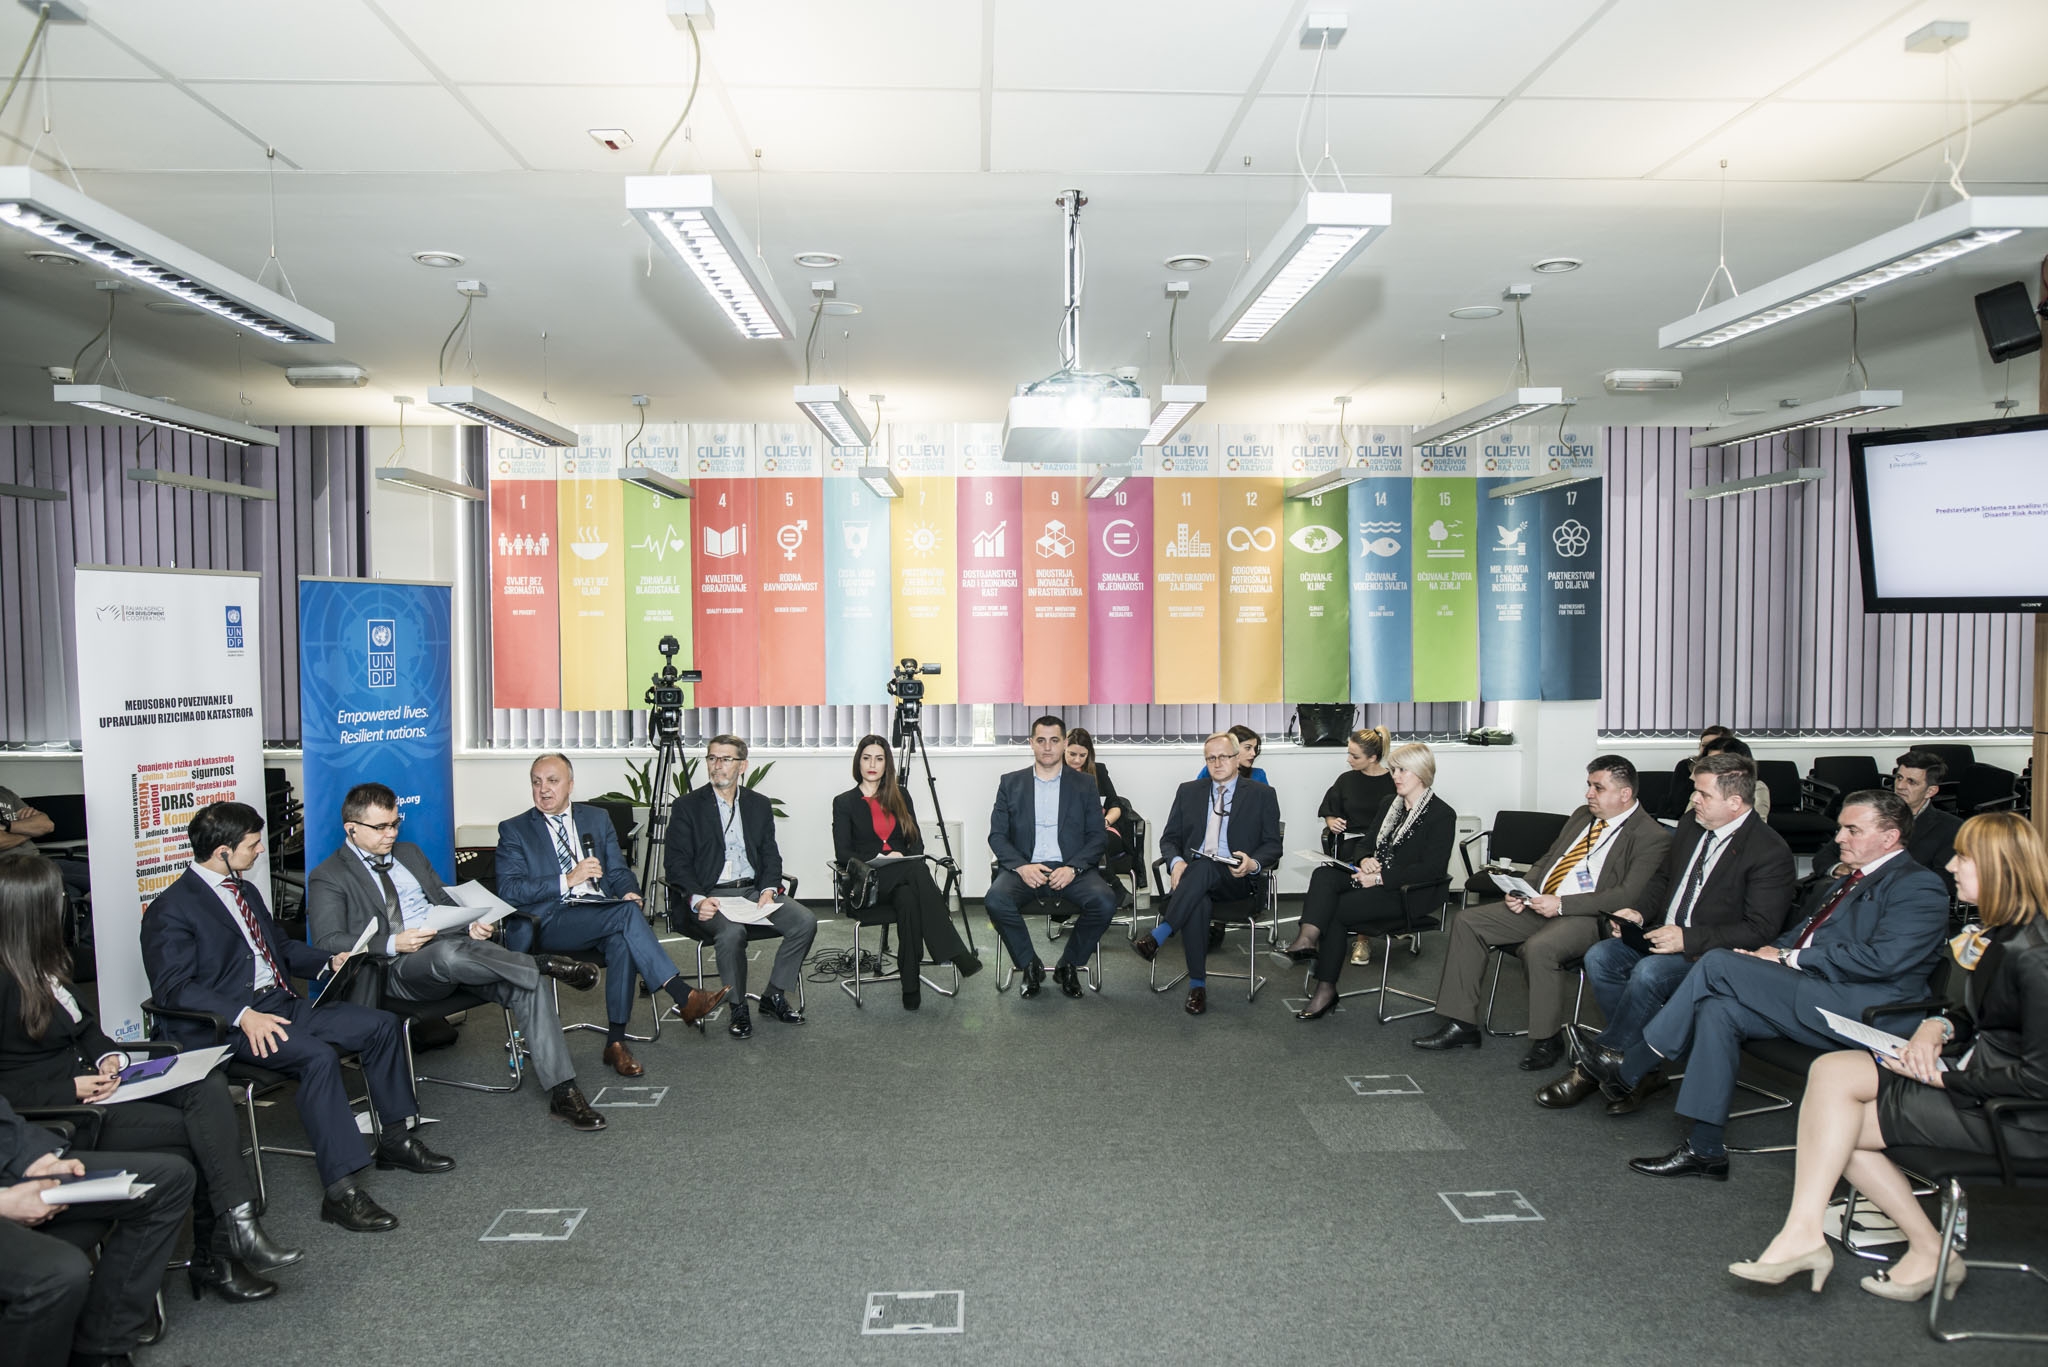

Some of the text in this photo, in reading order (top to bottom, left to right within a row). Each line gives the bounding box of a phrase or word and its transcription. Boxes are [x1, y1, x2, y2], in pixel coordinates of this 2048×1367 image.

[498, 447, 546, 460] CILJEVI
[564, 447, 612, 459] CILJEVI
[631, 447, 679, 459] CILJEVI
[697, 446, 745, 458] CILJEVI
[764, 445, 812, 458] CILJEVI
[897, 445, 945, 457] CILJEVI
[964, 445, 1003, 457] CILJE
[1161, 445, 1209, 457] CILJEVI
[1227, 445, 1274, 457] CILJEVI
[1292, 446, 1339, 458] CILJEVI
[1356, 445, 1402, 458] CILJEVI
[1421, 445, 1467, 458] CILJEVI
[1484, 445, 1530, 457] CILJEVI
[1548, 445, 1593, 457] CILJEVI
[1043, 463, 1077, 471] RAZVOJA
[1174, 464, 1209, 472] RAZVOJA
[1240, 464, 1273, 472] RAZVOJA
[1369, 464, 1402, 472] RAZVOJA
[1433, 464, 1466, 472] RAZVOJA
[1497, 464, 1530, 472] RAZVOJA
[520, 494, 526, 509] 1
[585, 494, 593, 509] 2
[652, 494, 661, 509] 3
[718, 493, 727, 508] 4
[785, 492, 794, 507] 5
[851, 492, 860, 506] 6
[920, 491, 926, 506] 7
[985, 491, 993, 506] 8
[1051, 491, 1059, 506] 9
[1114, 492, 1127, 506] 10
[1181, 492, 1192, 506] 11
[1246, 492, 1258, 506] 12
[1311, 495, 1323, 507] 13
[1375, 492, 1387, 506] 14
[1439, 492, 1451, 506] 15
[1566, 491, 1577, 506] 17
[1935, 506, 1980, 515] Predstavljanje
[1981, 504, 2008, 512] Sistema
[962, 569, 1017, 579] DOSTOJANSTVEN
[1232, 566, 1271, 575] ODGOVORNA
[1504, 564, 1529, 574] PRAVDA
[506, 576, 542, 586] SVIJET BEZ
[705, 574, 744, 584] KVALITETNO
[779, 573, 802, 582] RODNA
[1102, 572, 1140, 582] SMANJENJE
[1231, 574, 1269, 584] POTROŠNJA
[1300, 571, 1333, 582] OČUVANJE
[1365, 571, 1398, 581] OČUVANJE
[1417, 570, 1473, 582] OČUVANJE ŽIVOTA
[1499, 573, 1523, 583] SNAŽNE
[1547, 571, 1595, 581] PARTNERSTVOM
[701, 583, 748, 593] OBRAZOVANJE
[763, 582, 819, 592] RAVNOPRAVNOST
[962, 579, 976, 588] RAD
[1037, 578, 1070, 588] INOVACIJE
[1097, 582, 1144, 592] NEJEDNAKOSTI
[1170, 582, 1204, 592] ZAJEDNICE
[1229, 584, 1273, 594] PROIZVODNJA
[1307, 582, 1326, 591] KLIME
[1384, 581, 1408, 591] SVIJETA
[1429, 581, 1438, 591] NA
[1491, 583, 1527, 592] INSTITUCIJE
[1554, 580, 1589, 590] DO CILJEVA
[981, 588, 999, 597] RAST
[1028, 587, 1083, 597] INFRASTRUKTURA
[178, 695, 227, 708] POVEZIVANJE
[227, 694, 233, 705] U
[99, 707, 254, 728] UPRAVLJANJU RIZICIMA OD KATASTROFA
[337, 705, 429, 727] Empowered lives.
[340, 726, 428, 745] Resilient nations.
[137, 755, 235, 773] Smanjenje rizika od katastrofa
[191, 765, 235, 780] sigurnost
[160, 779, 237, 794] Planiranje strateški plan
[138, 782, 151, 830] Klizišta
[150, 784, 161, 826] poplave
[161, 790, 236, 812] DRAS saradnja
[395, 795, 421, 807] dp.org
[145, 827, 169, 839] jedinice
[136, 862, 173, 878] Smanjenje
[115, 1023, 140, 1037] CILJEVI
